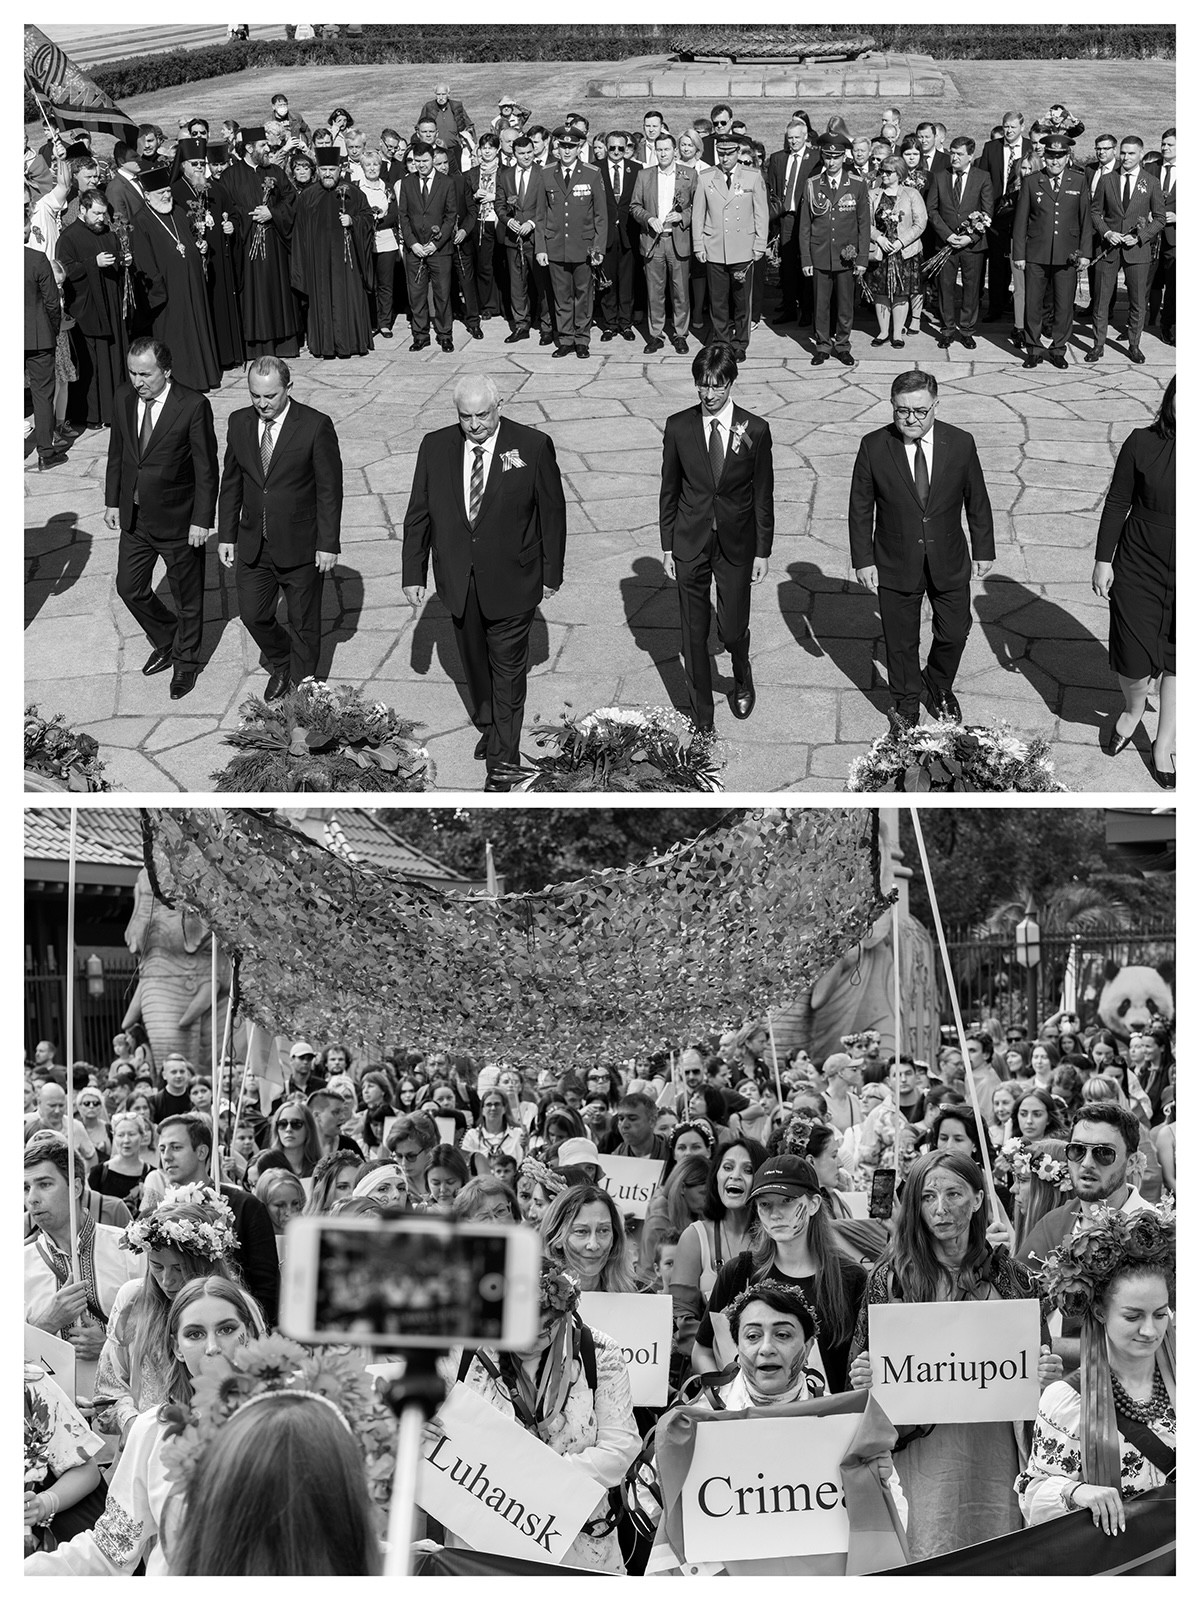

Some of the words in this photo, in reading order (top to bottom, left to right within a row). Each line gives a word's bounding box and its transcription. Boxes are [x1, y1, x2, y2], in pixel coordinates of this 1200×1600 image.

[881, 1350, 1029, 1389] Mariupol
[424, 1435, 562, 1554] Luhansk
[697, 1472, 848, 1518] Crime
